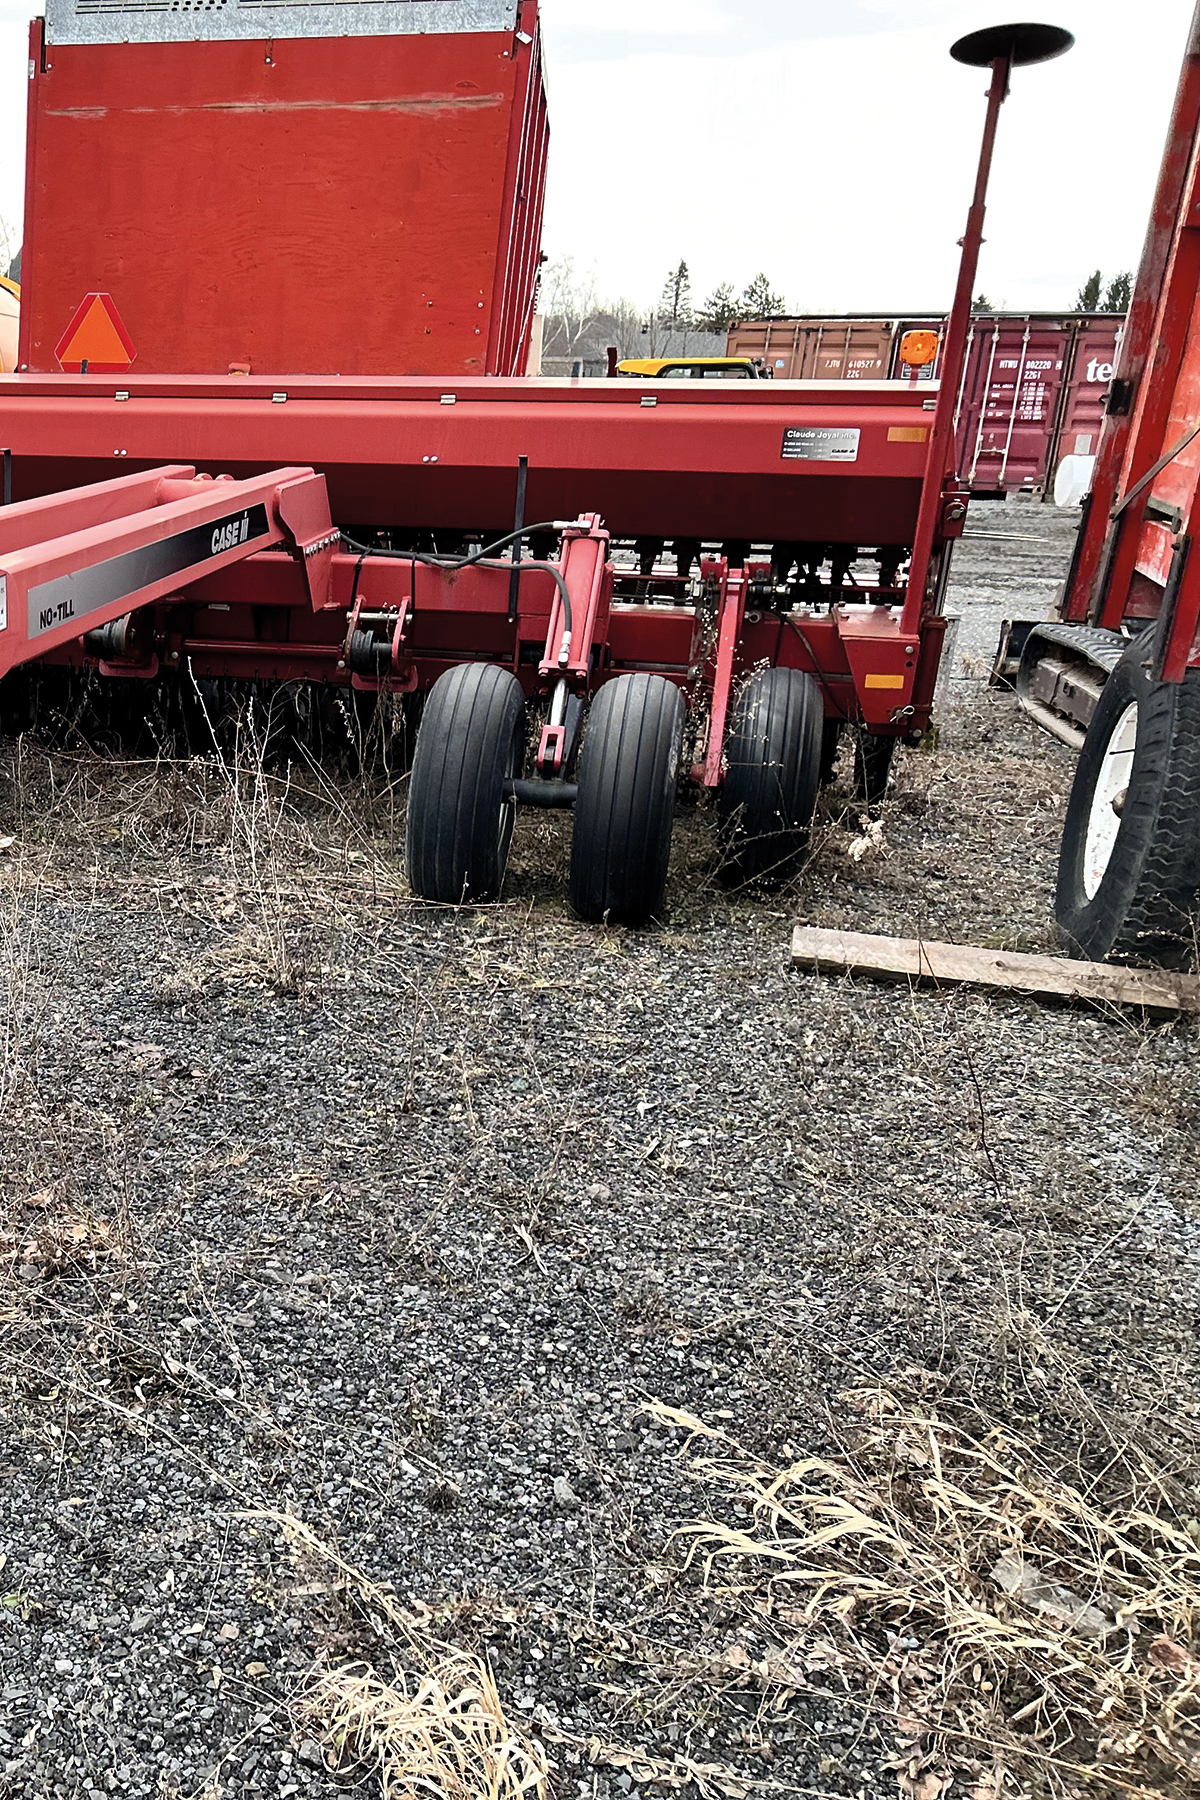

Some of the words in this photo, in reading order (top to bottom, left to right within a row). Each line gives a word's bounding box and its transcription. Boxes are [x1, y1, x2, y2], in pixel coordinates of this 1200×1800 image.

[787, 430, 816, 438] Claude
[817, 431, 840, 440] Joyal
[211, 520, 240, 554] CASE
[39, 599, 75, 630] NO-TILL
